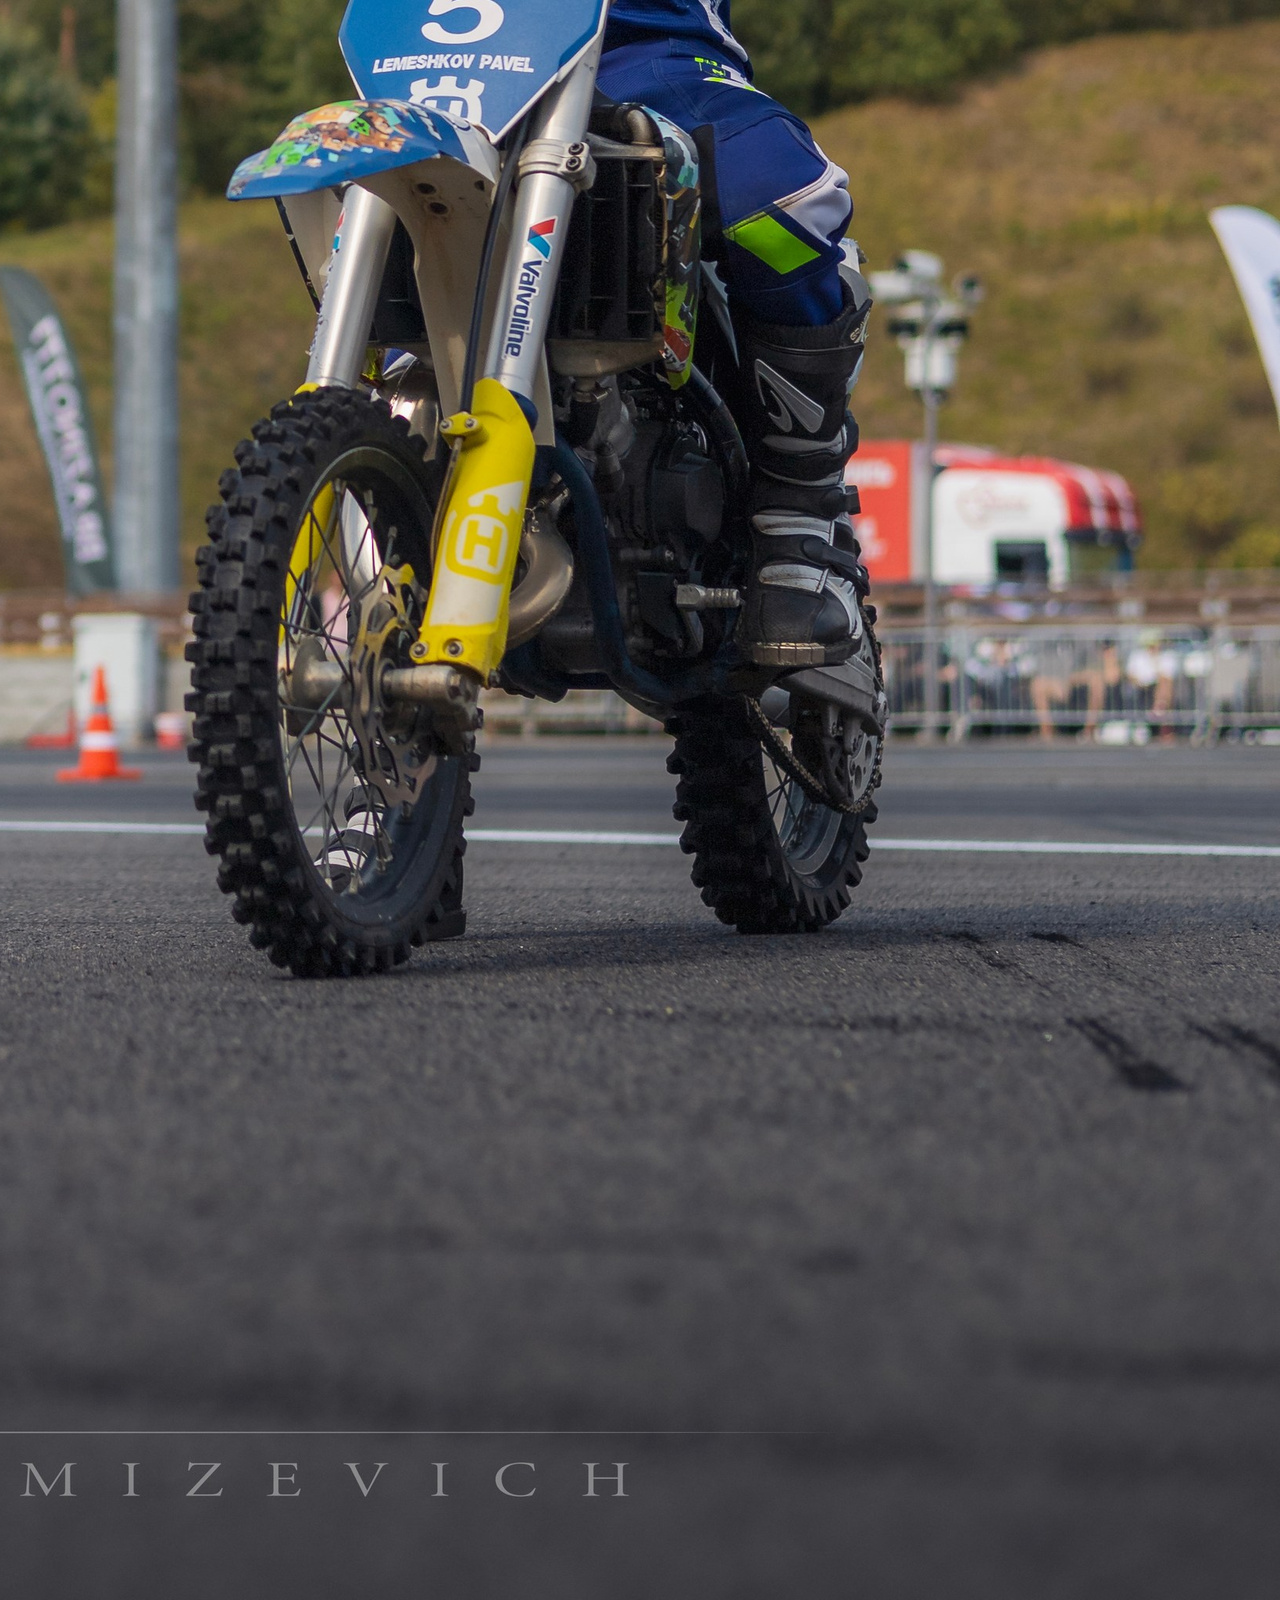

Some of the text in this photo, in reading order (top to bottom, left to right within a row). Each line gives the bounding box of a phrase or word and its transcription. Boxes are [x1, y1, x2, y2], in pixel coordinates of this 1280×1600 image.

[372, 53, 535, 74] LEMESHKOV PAVEL
[504, 258, 543, 358] Valvoline
